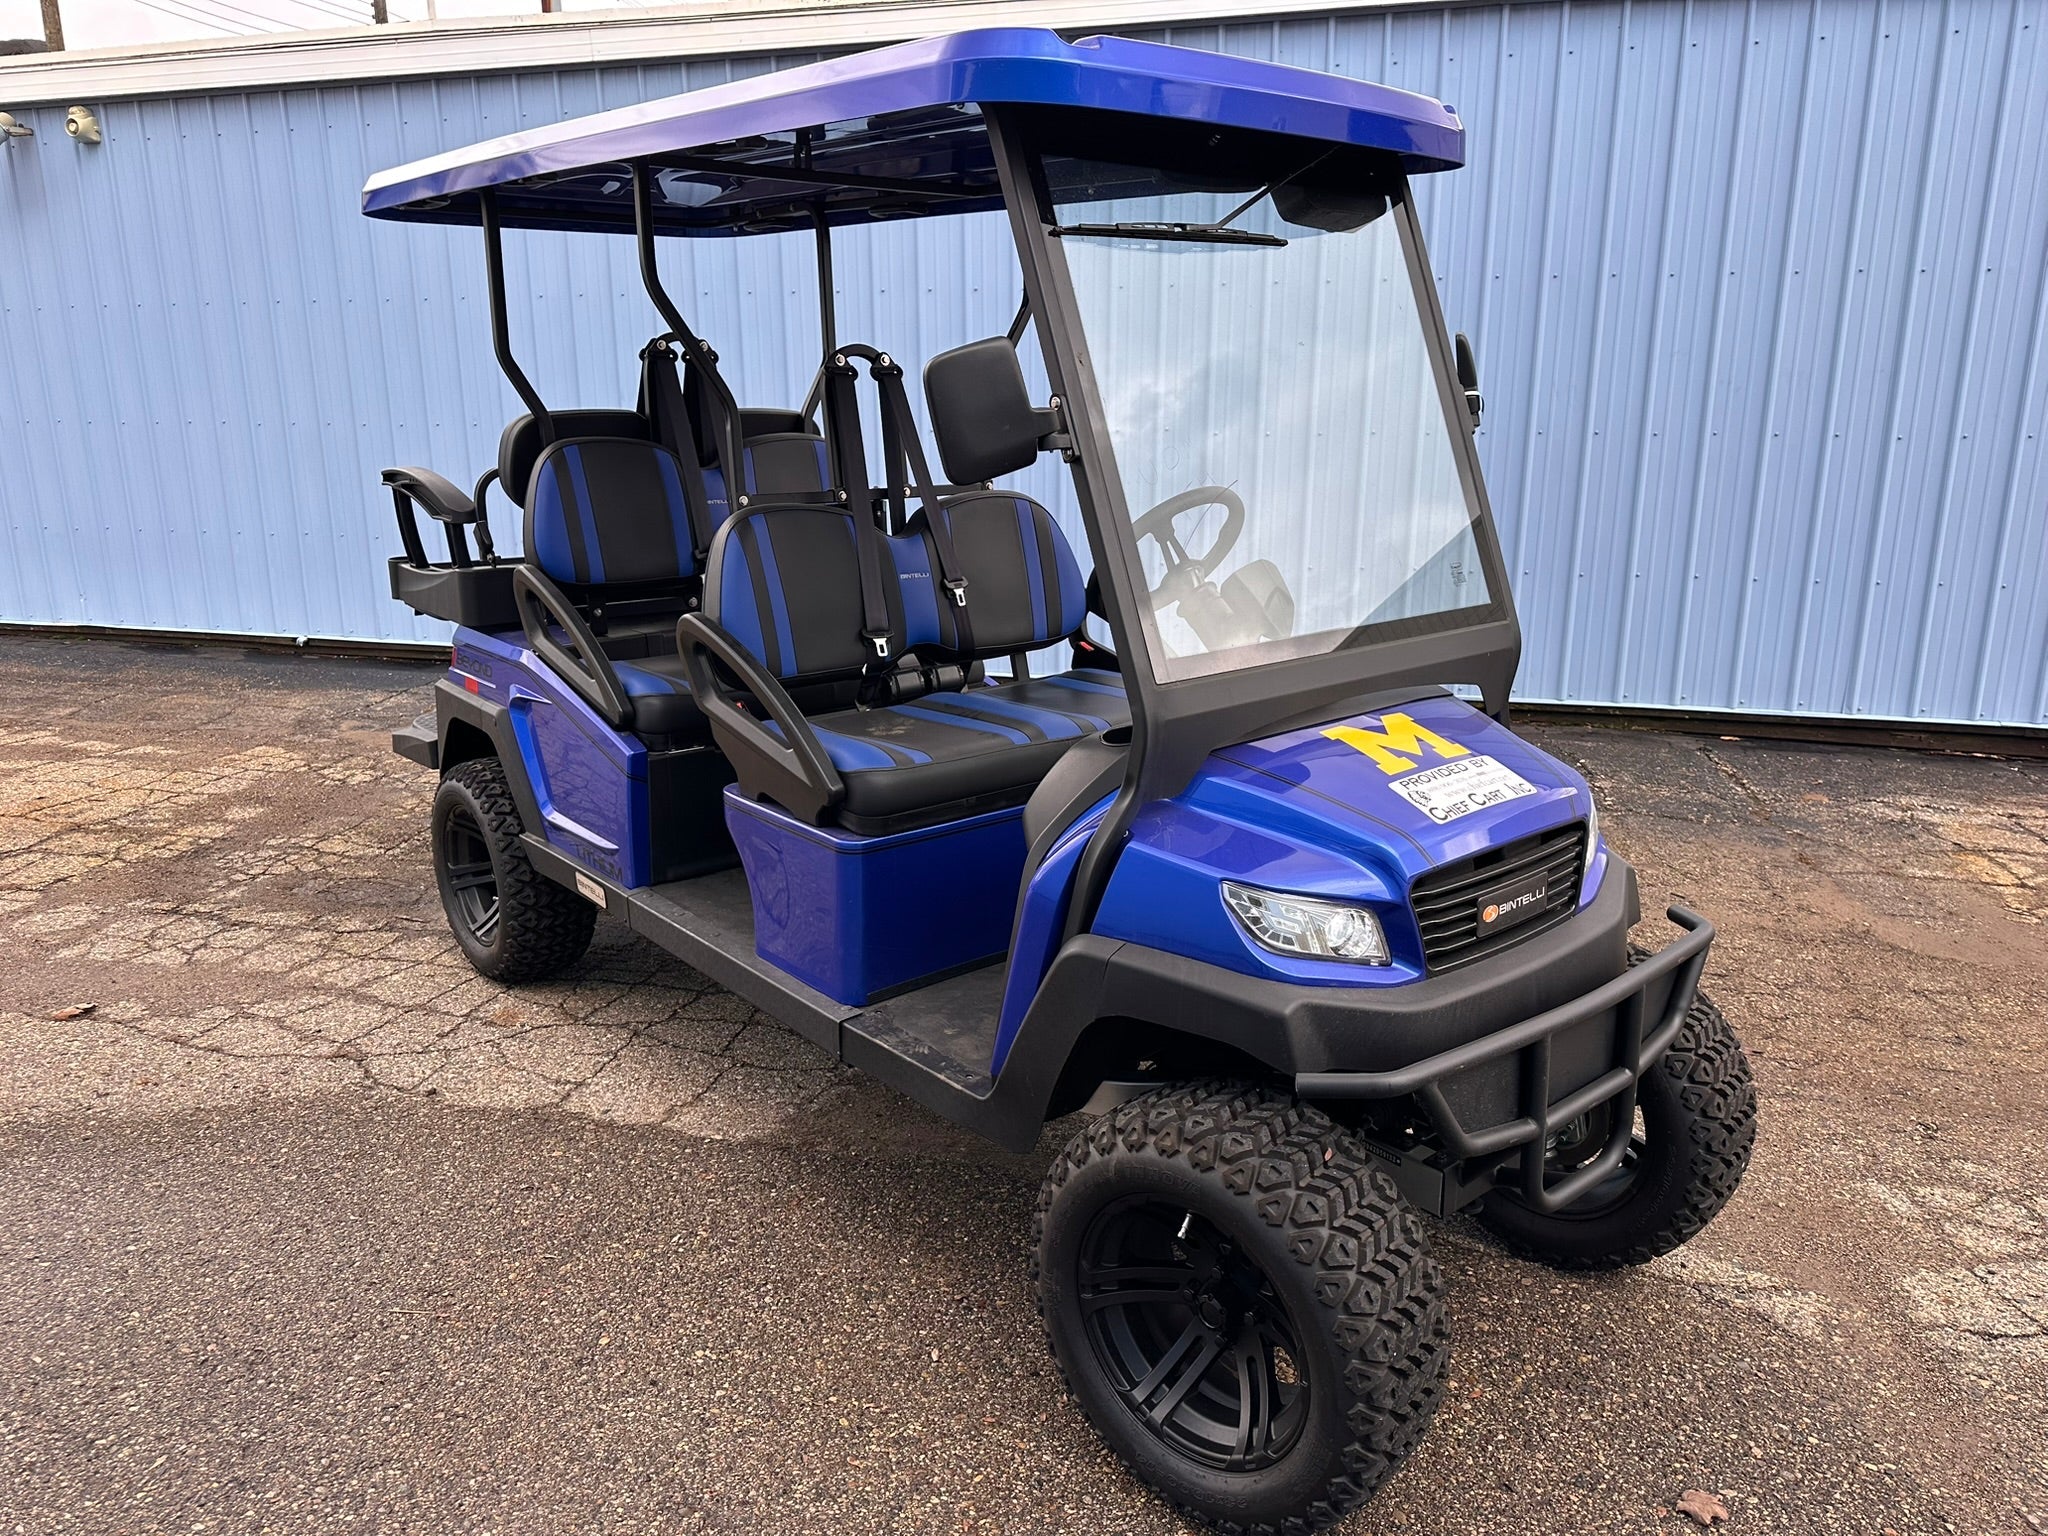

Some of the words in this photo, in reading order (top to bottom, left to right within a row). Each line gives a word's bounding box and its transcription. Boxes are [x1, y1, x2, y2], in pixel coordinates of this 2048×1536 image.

[1319, 712, 1472, 776] M
[1400, 763, 1469, 790] PROVIDED
[1469, 757, 1489, 768] BY
[1499, 886, 1545, 915] BINTELLI
